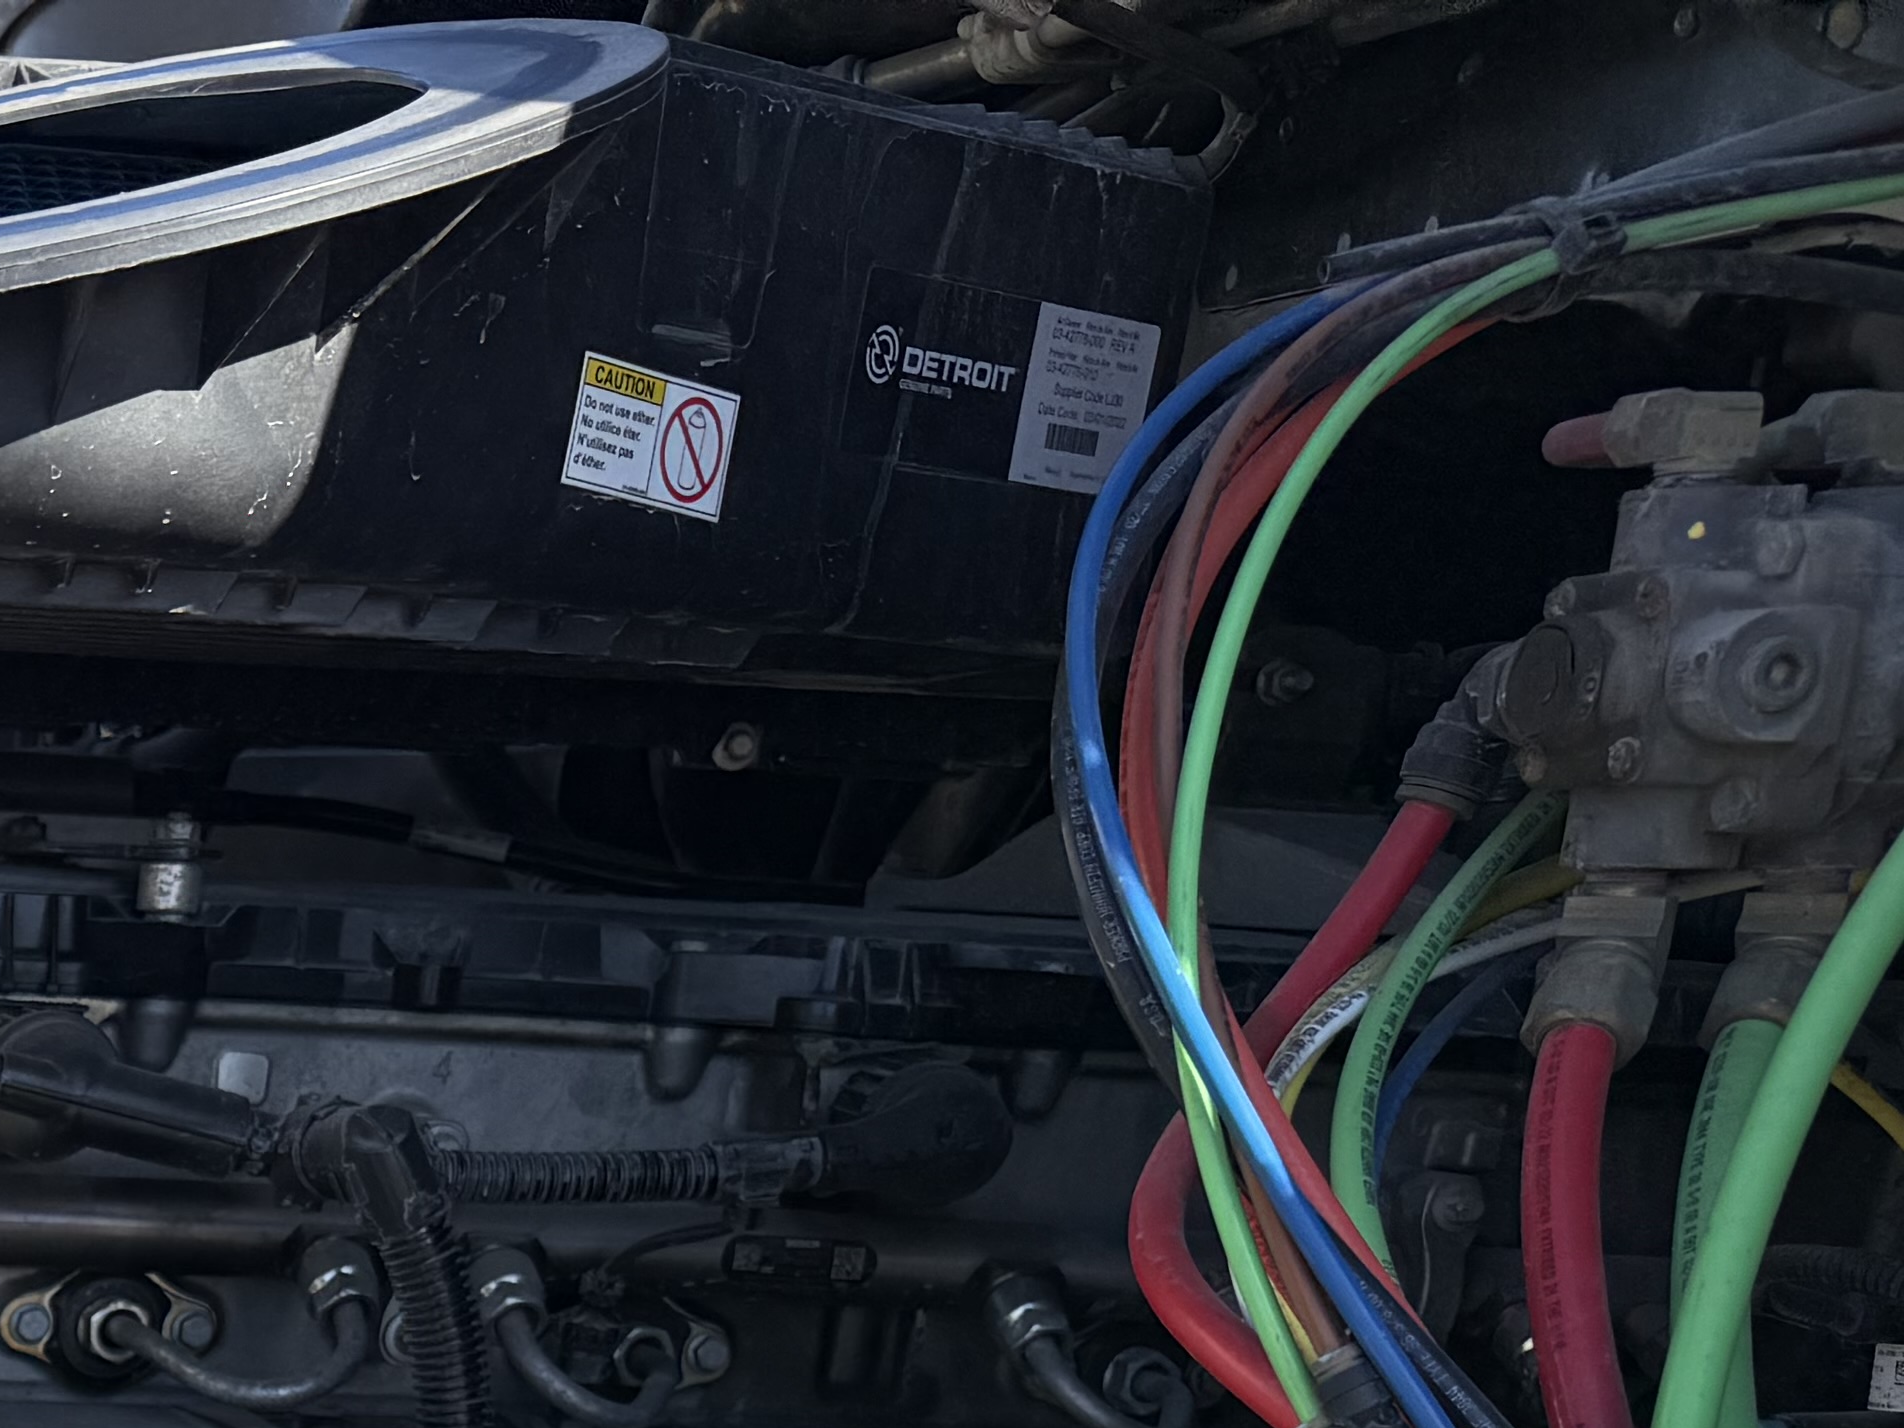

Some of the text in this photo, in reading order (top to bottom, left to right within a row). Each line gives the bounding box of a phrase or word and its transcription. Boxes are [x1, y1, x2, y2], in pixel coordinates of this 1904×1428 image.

[902, 346, 1016, 392] DETROIT
[594, 365, 656, 400] CAUTION
[584, 394, 598, 411] Do
[599, 399, 614, 414] not
[615, 405, 631, 420] use
[581, 414, 594, 428] No
[618, 446, 635, 460] pas
